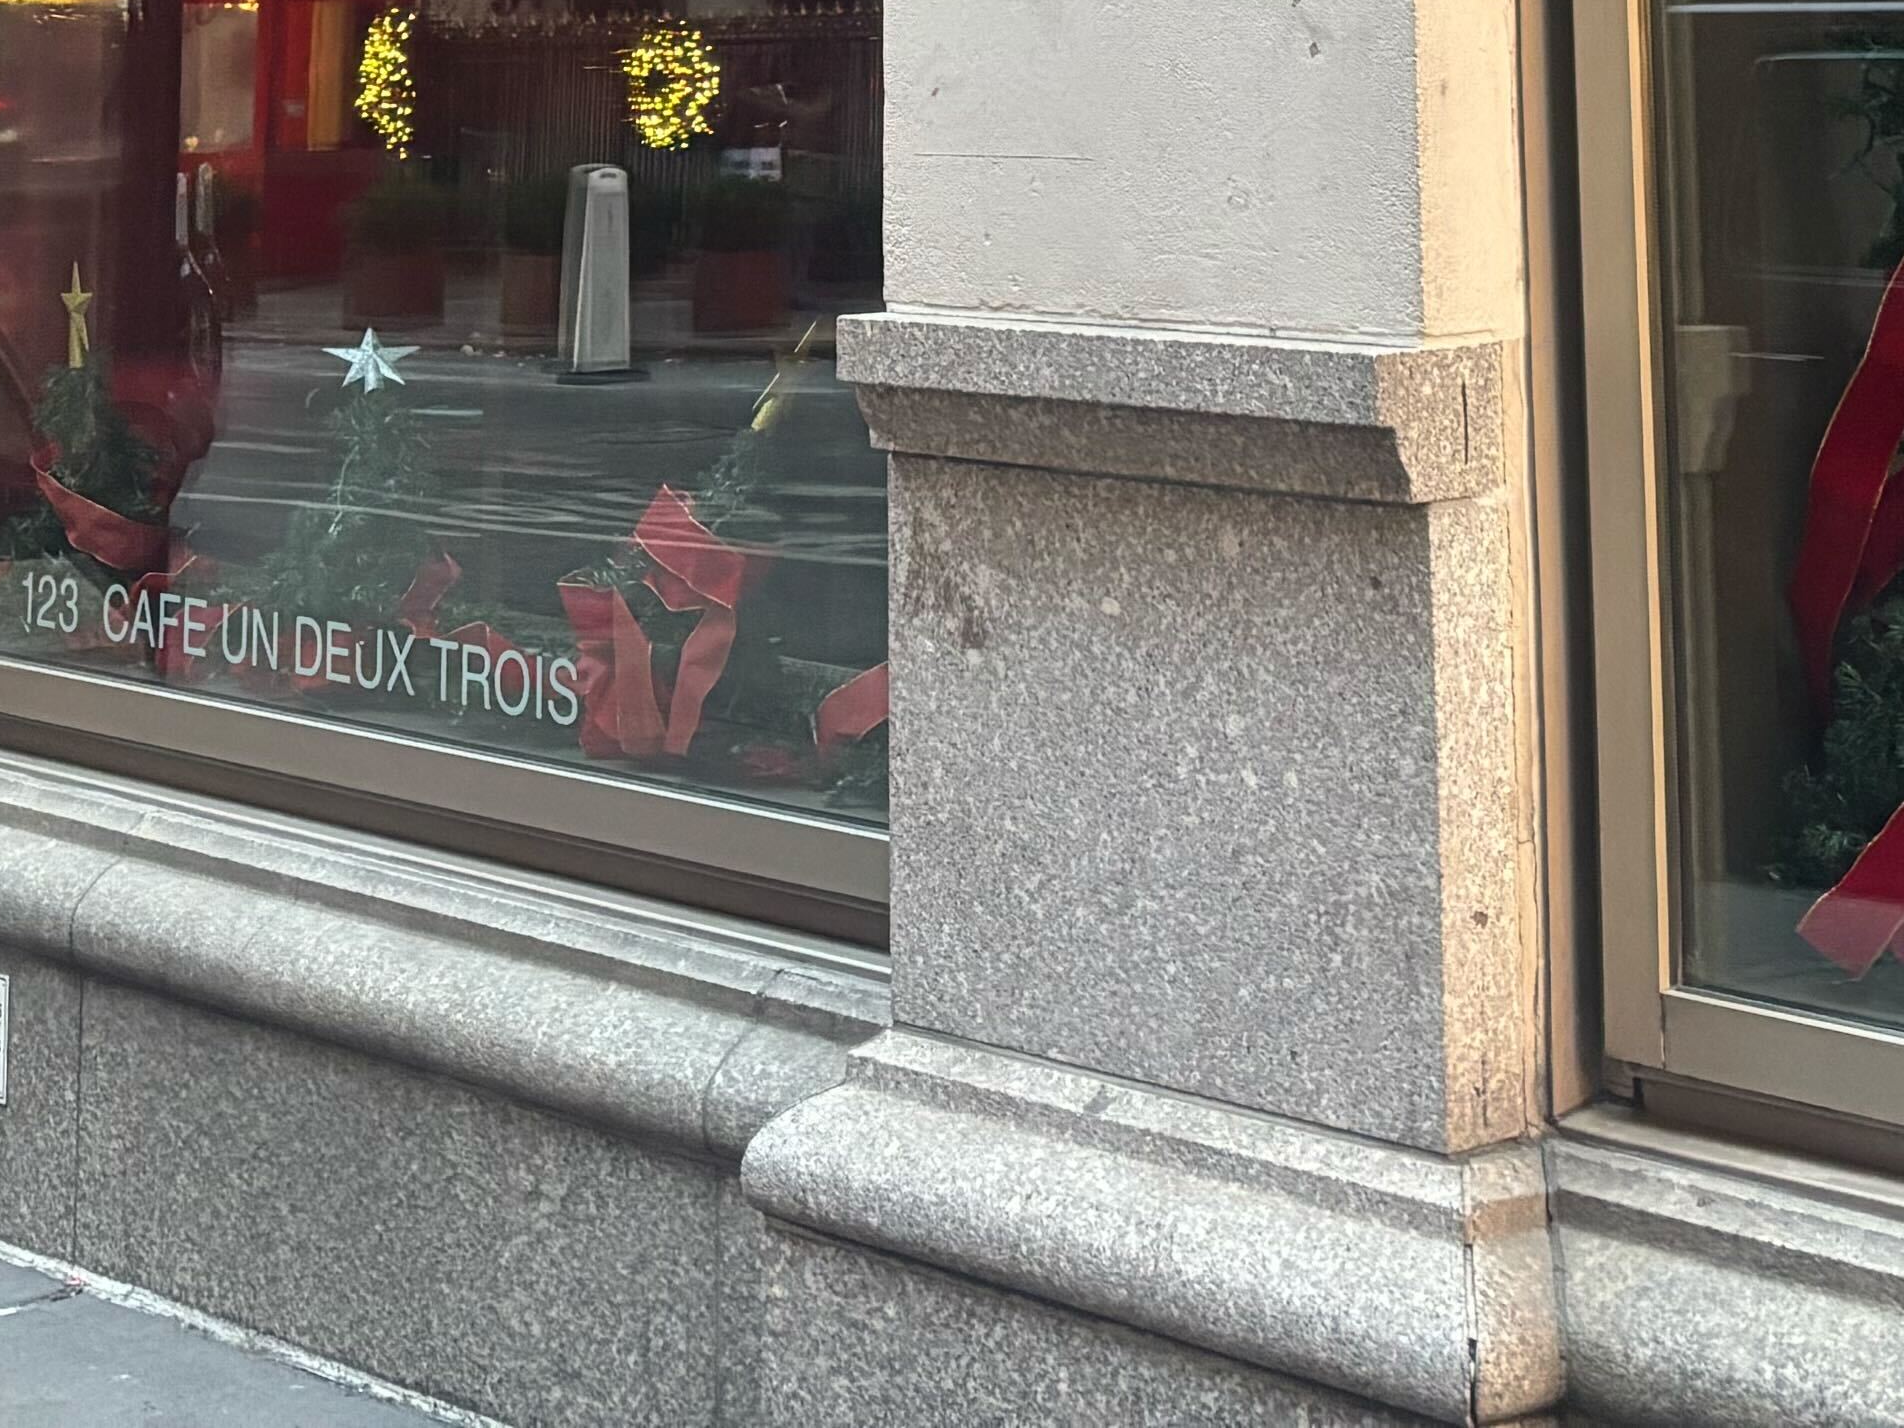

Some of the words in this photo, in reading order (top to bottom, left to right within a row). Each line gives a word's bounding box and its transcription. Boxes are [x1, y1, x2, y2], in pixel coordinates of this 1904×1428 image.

[22, 571, 79, 633] 123
[103, 584, 208, 657] CAFE
[222, 603, 279, 671] UN
[295, 615, 415, 696] DEUX
[430, 638, 578, 726] TROIS
